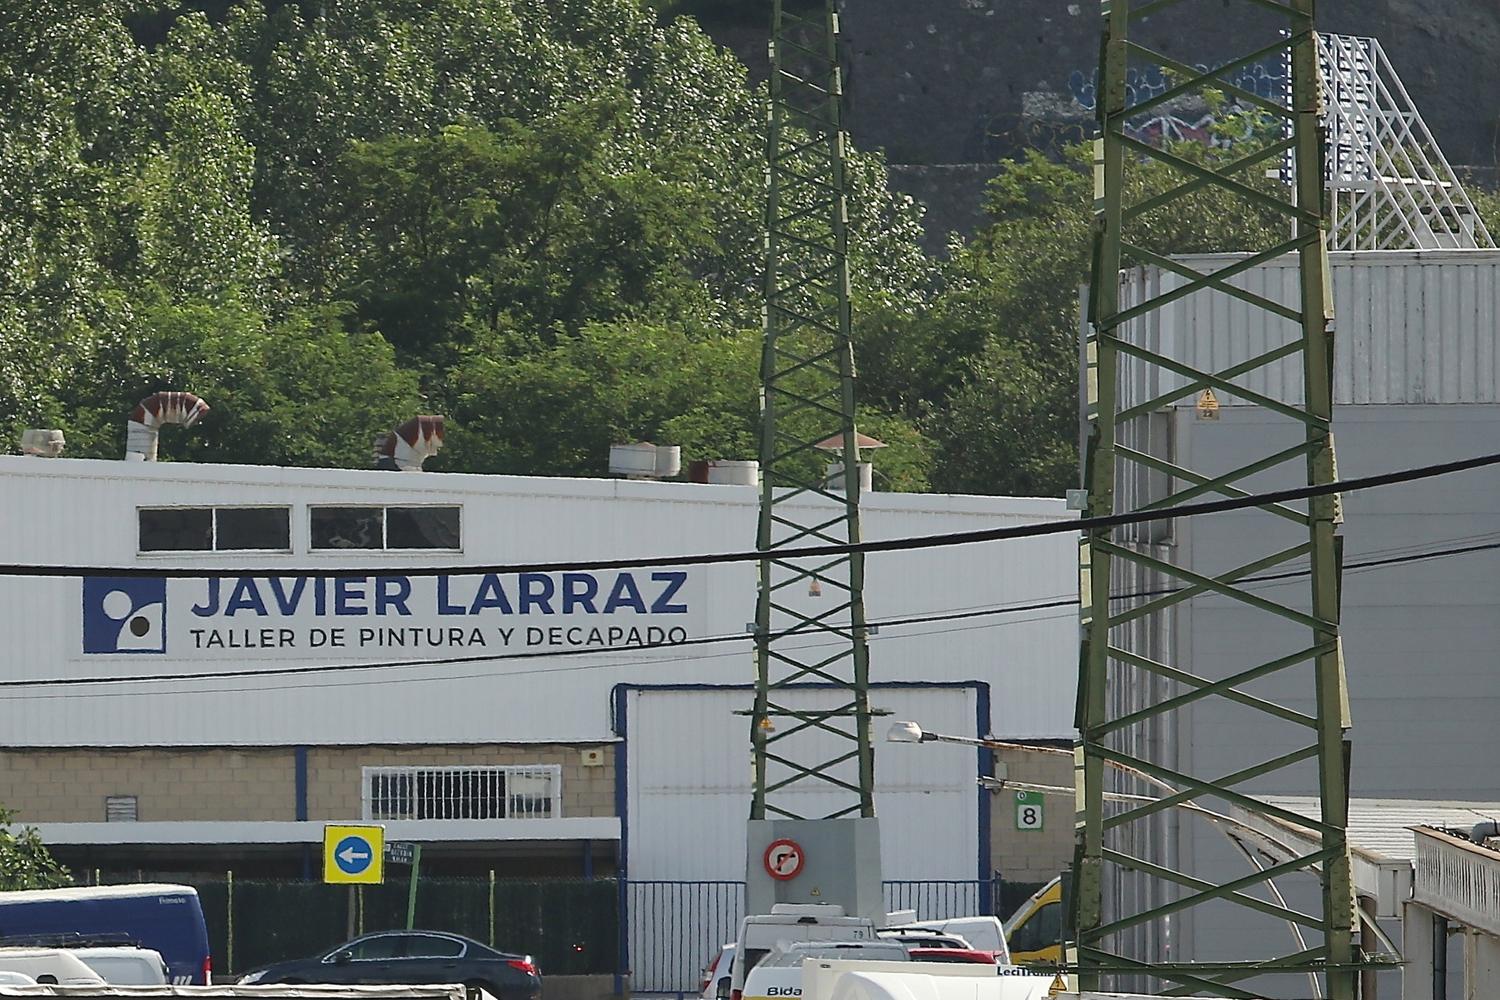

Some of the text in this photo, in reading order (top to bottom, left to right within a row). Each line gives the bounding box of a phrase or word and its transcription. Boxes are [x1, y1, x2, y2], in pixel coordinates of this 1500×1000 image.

[1072, 493, 1080, 507] 2
[190, 572, 688, 617] JAVIER LARRAZ
[190, 626, 688, 648] TALLER DE PINTURA Y DECAPADO
[1022, 807, 1037, 825] 8
